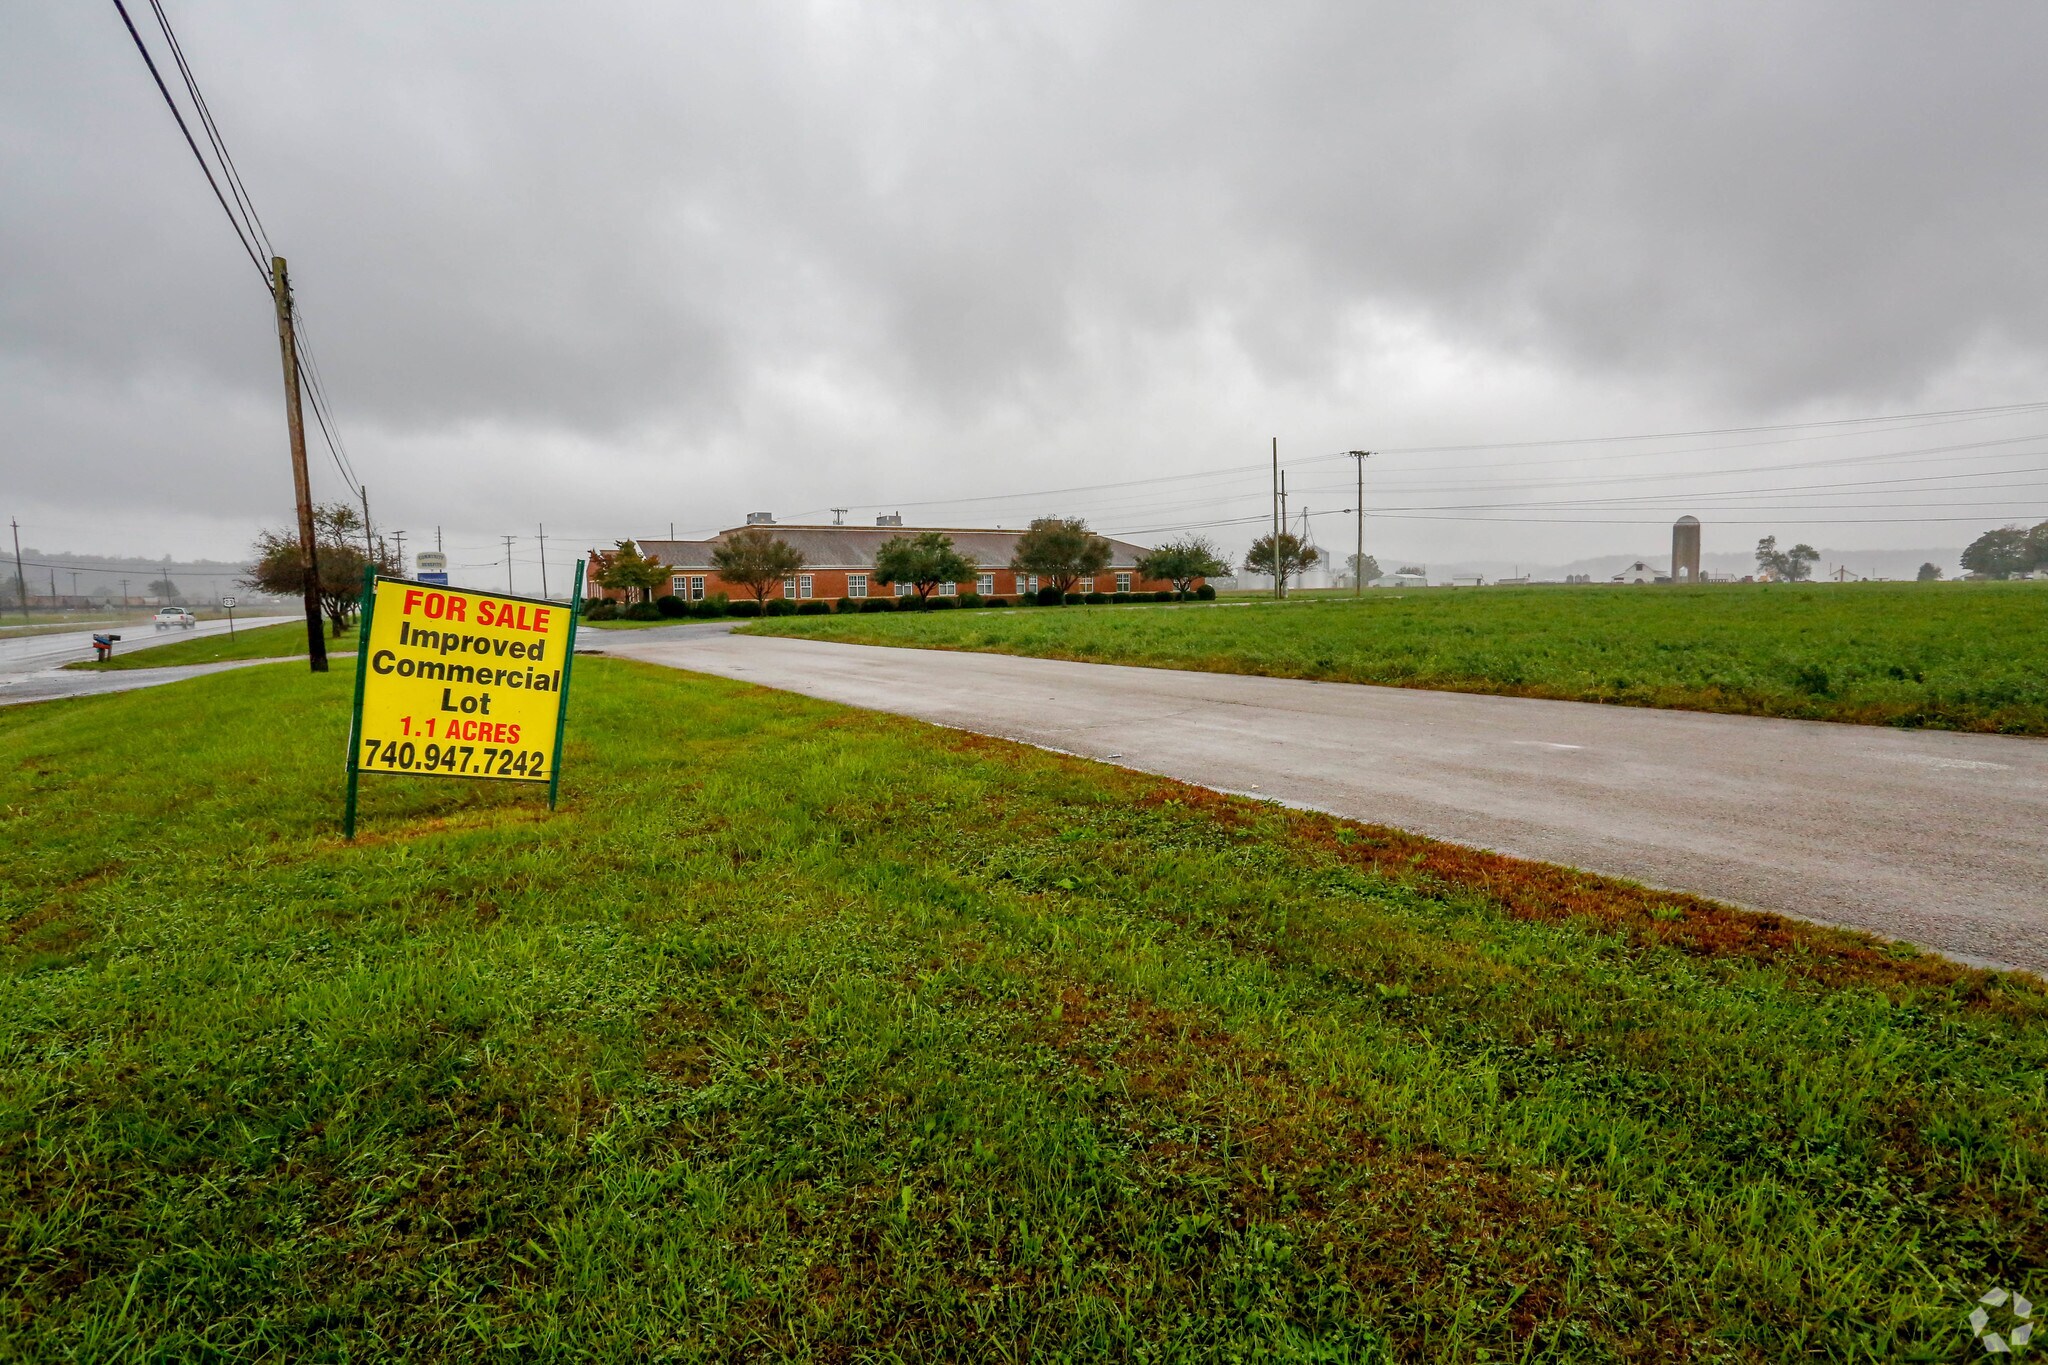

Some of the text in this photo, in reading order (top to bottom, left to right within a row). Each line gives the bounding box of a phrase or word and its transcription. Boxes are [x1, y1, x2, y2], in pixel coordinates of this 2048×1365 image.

[403, 590, 551, 632] FOR SALE
[399, 621, 546, 661] Improved
[372, 649, 561, 692] Commercial
[441, 688, 491, 715] Lot
[400, 716, 521, 744] 1.1 ACRES
[365, 739, 544, 777] 740.947.7242
